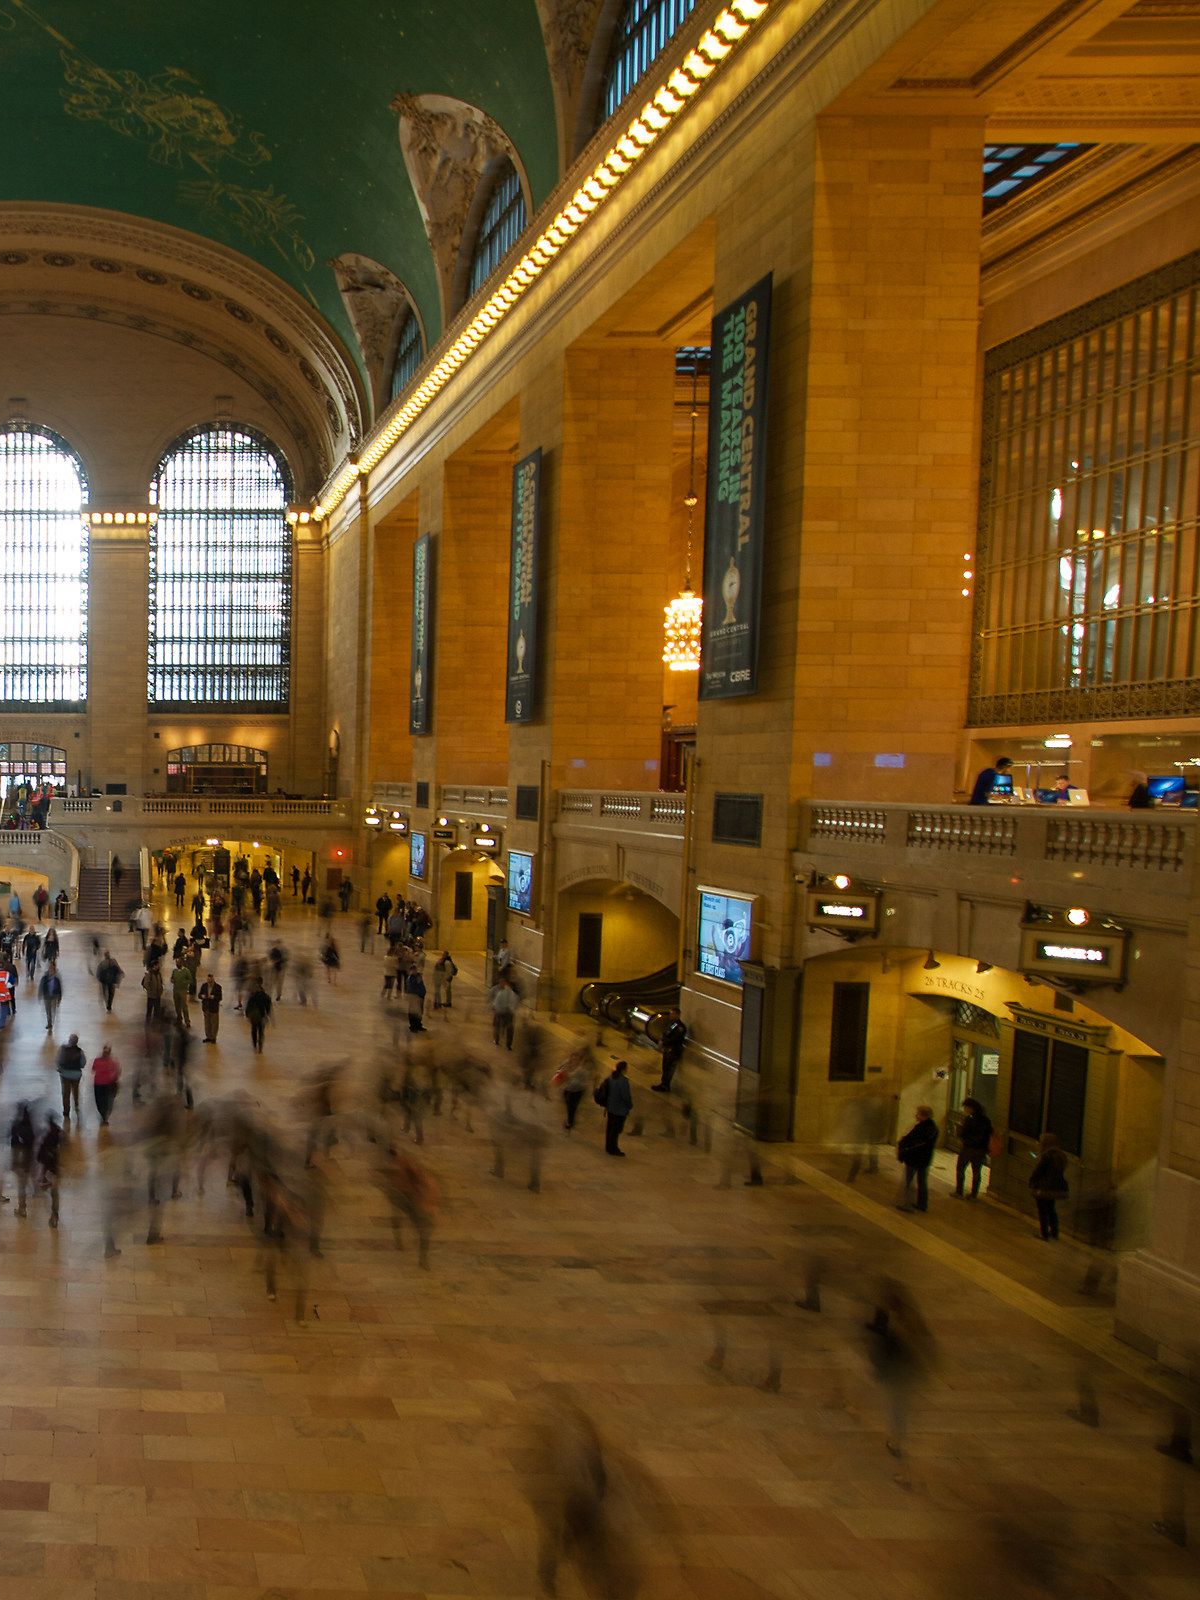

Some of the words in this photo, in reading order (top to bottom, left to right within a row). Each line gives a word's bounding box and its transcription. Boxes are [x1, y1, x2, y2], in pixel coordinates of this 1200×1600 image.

[722, 313, 735, 373] THE
[733, 306, 746, 363] 100
[743, 301, 757, 409] GRAND
[718, 379, 732, 502] MAKING
[730, 366, 744, 465] YEARS
[728, 473, 741, 504] IN
[738, 415, 754, 552] CENTRAL
[520, 464, 530, 604] CELEBRATION
[525, 479, 535, 608] CENTENNIAL
[514, 547, 522, 620] GRAND
[730, 668, 751, 682] CBRE
[936, 977, 973, 996] TRACKS
[974, 987, 985, 1000] 25
